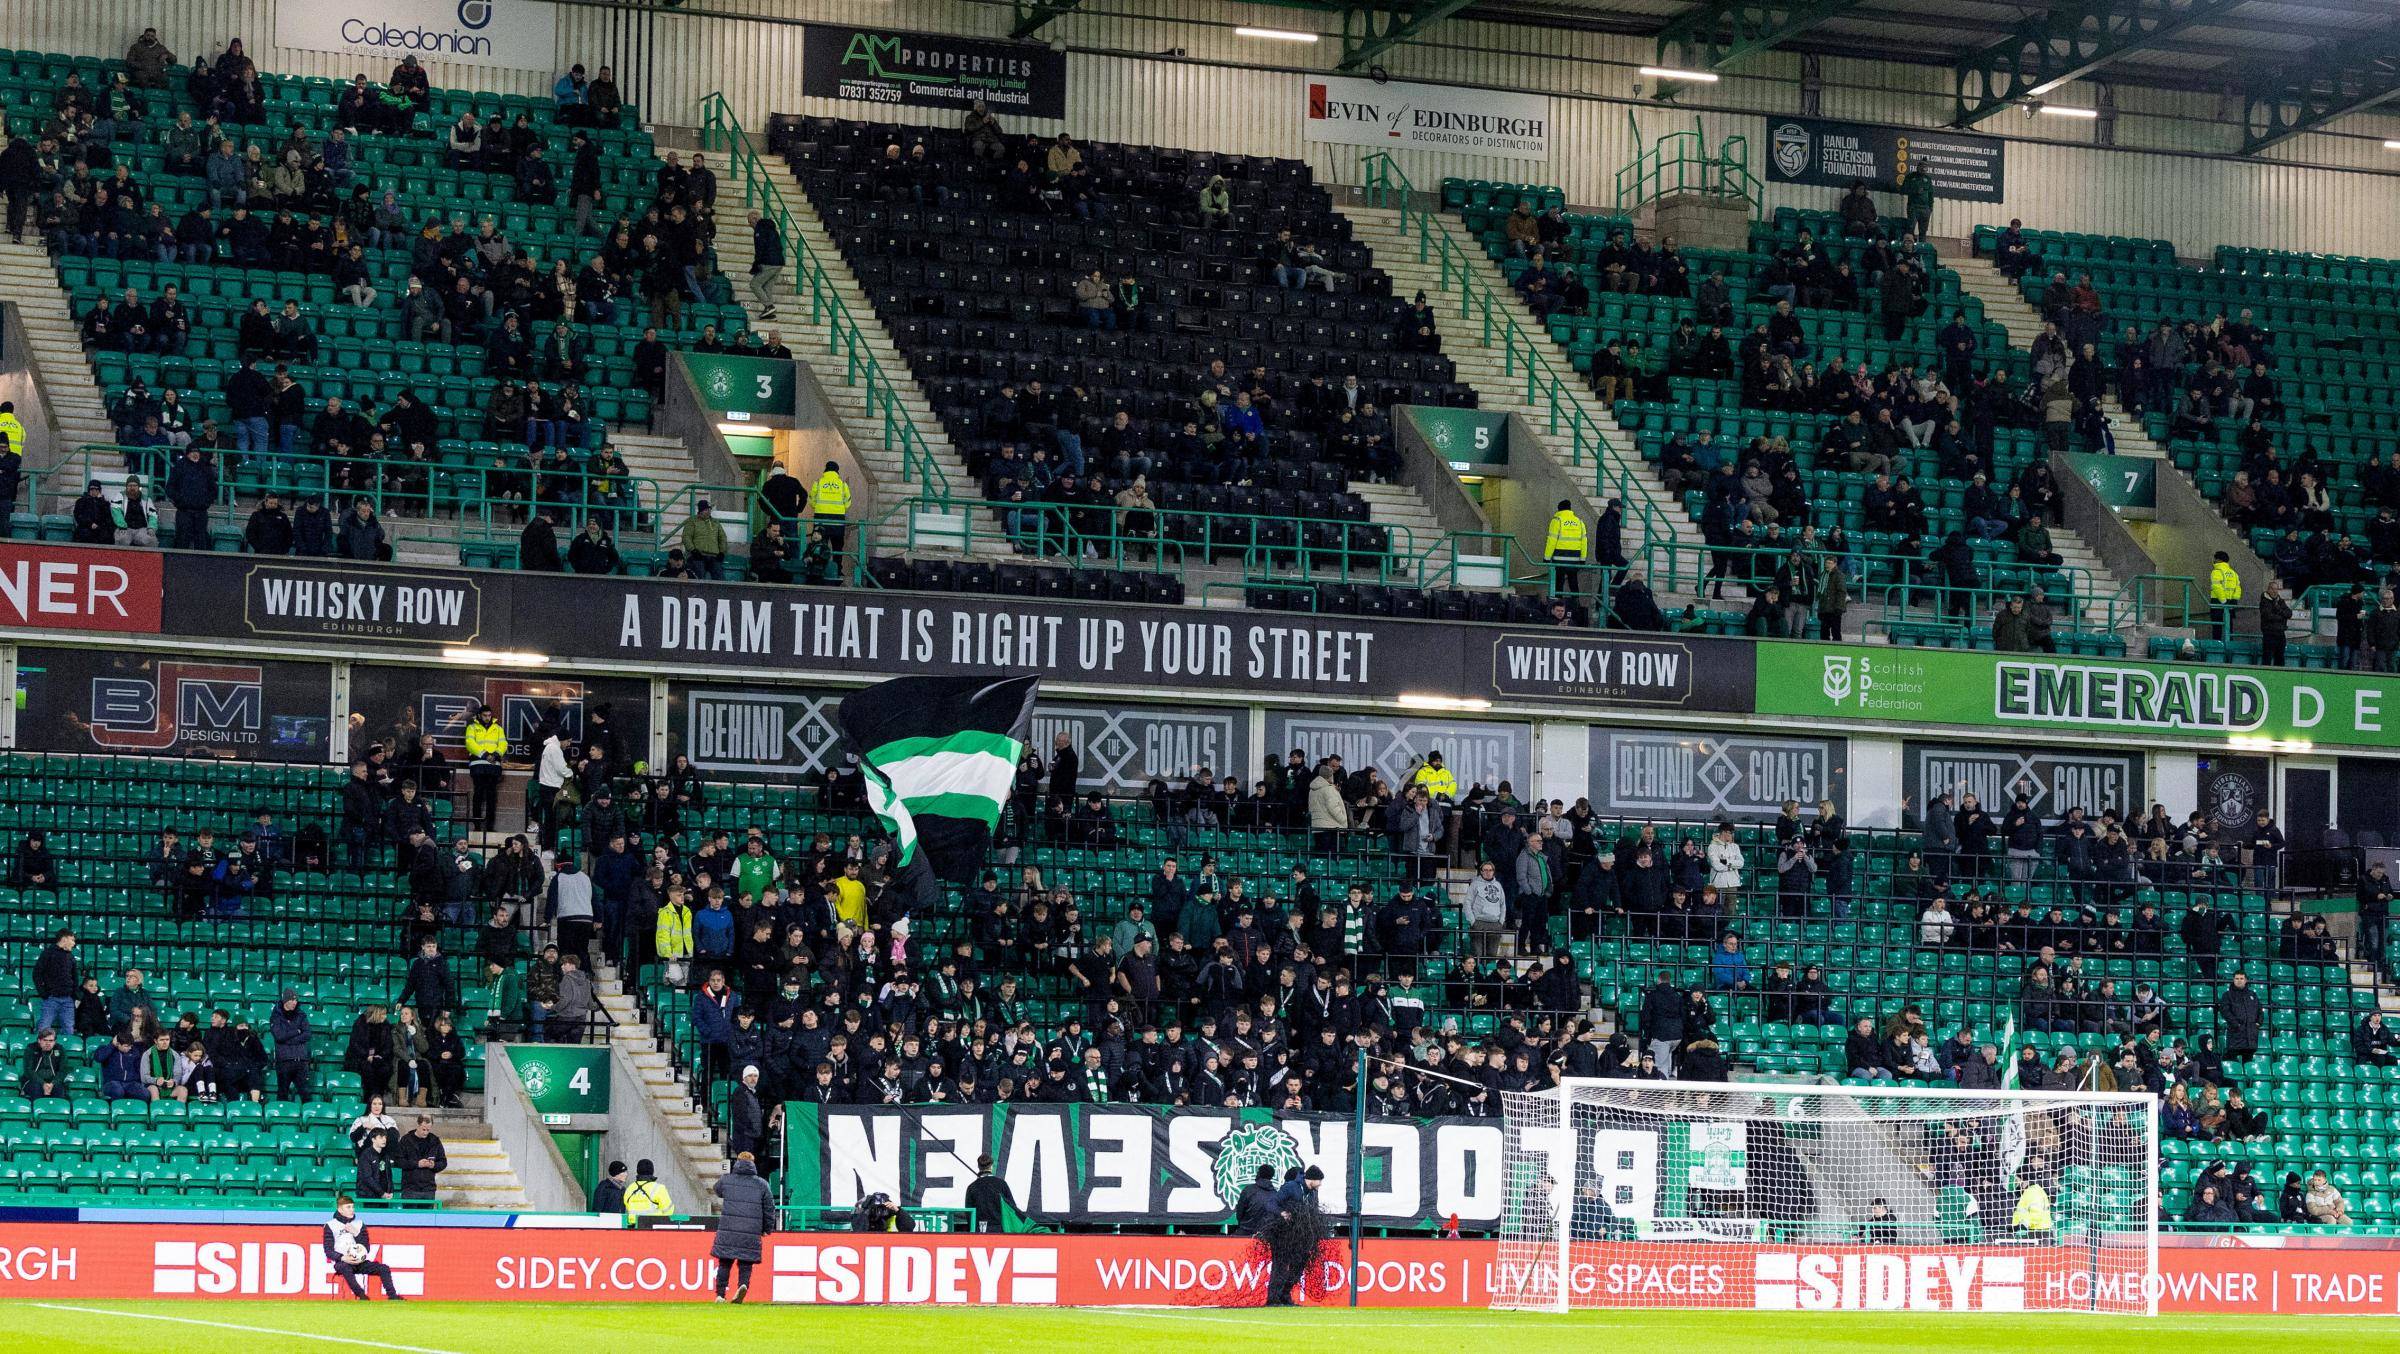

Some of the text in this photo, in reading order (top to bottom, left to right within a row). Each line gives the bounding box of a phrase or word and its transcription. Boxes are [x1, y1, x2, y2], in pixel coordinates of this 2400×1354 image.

[342, 18, 491, 56] Caledonian
[902, 49, 1031, 77] PROPERTIES
[839, 85, 902, 102] 07831 352759
[909, 81, 1030, 105] Commercial and Industrial
[1000, 79, 1026, 90] Limited
[1310, 100, 1544, 138] NEVIN of EDINBURGH
[1412, 131, 1543, 152] DECORATORS OF DISTINCTION
[1823, 135, 1859, 150] HANLON
[1822, 150, 1874, 164] STEVENSON
[1822, 162, 1877, 178] FOUNDATION
[756, 375, 773, 398] 3
[1474, 427, 1489, 449] 5
[2124, 471, 2139, 493] 7
[262, 577, 466, 626] WHISKY ROW
[322, 622, 403, 635] EDINBURGH
[619, 594, 1374, 683] A DRAM THAT IS RIGHT UP YOUR STREET
[1507, 646, 1679, 687] WHISKY ROW
[1860, 656, 1924, 676] Scottish
[1558, 685, 1628, 696] EDINBURGH
[1860, 692, 1923, 711] Federation
[1997, 663, 2267, 730] EMERALD
[180, 728, 260, 744] DESIGN LTD.
[700, 703, 821, 761] BEHIND THE
[1107, 738, 1121, 757] THE
[1145, 723, 1218, 778] GOALS
[1620, 746, 1814, 803] BEHIND THE GOALS
[1930, 761, 2001, 813] BEHIND
[2054, 766, 2116, 817] GOALS
[569, 1067, 591, 1096] 4
[828, 1114, 1232, 1214] SEVEN
[818, 1245, 1011, 1303] SIDEY
[1324, 1260, 1446, 1293] DOORS
[1486, 1262, 1596, 1294] LIVING
[1605, 1264, 1725, 1295] SPACES
[1799, 1254, 1982, 1310] SIDEY
[2045, 1270, 2384, 1303] HOMEOWNER TRADE
